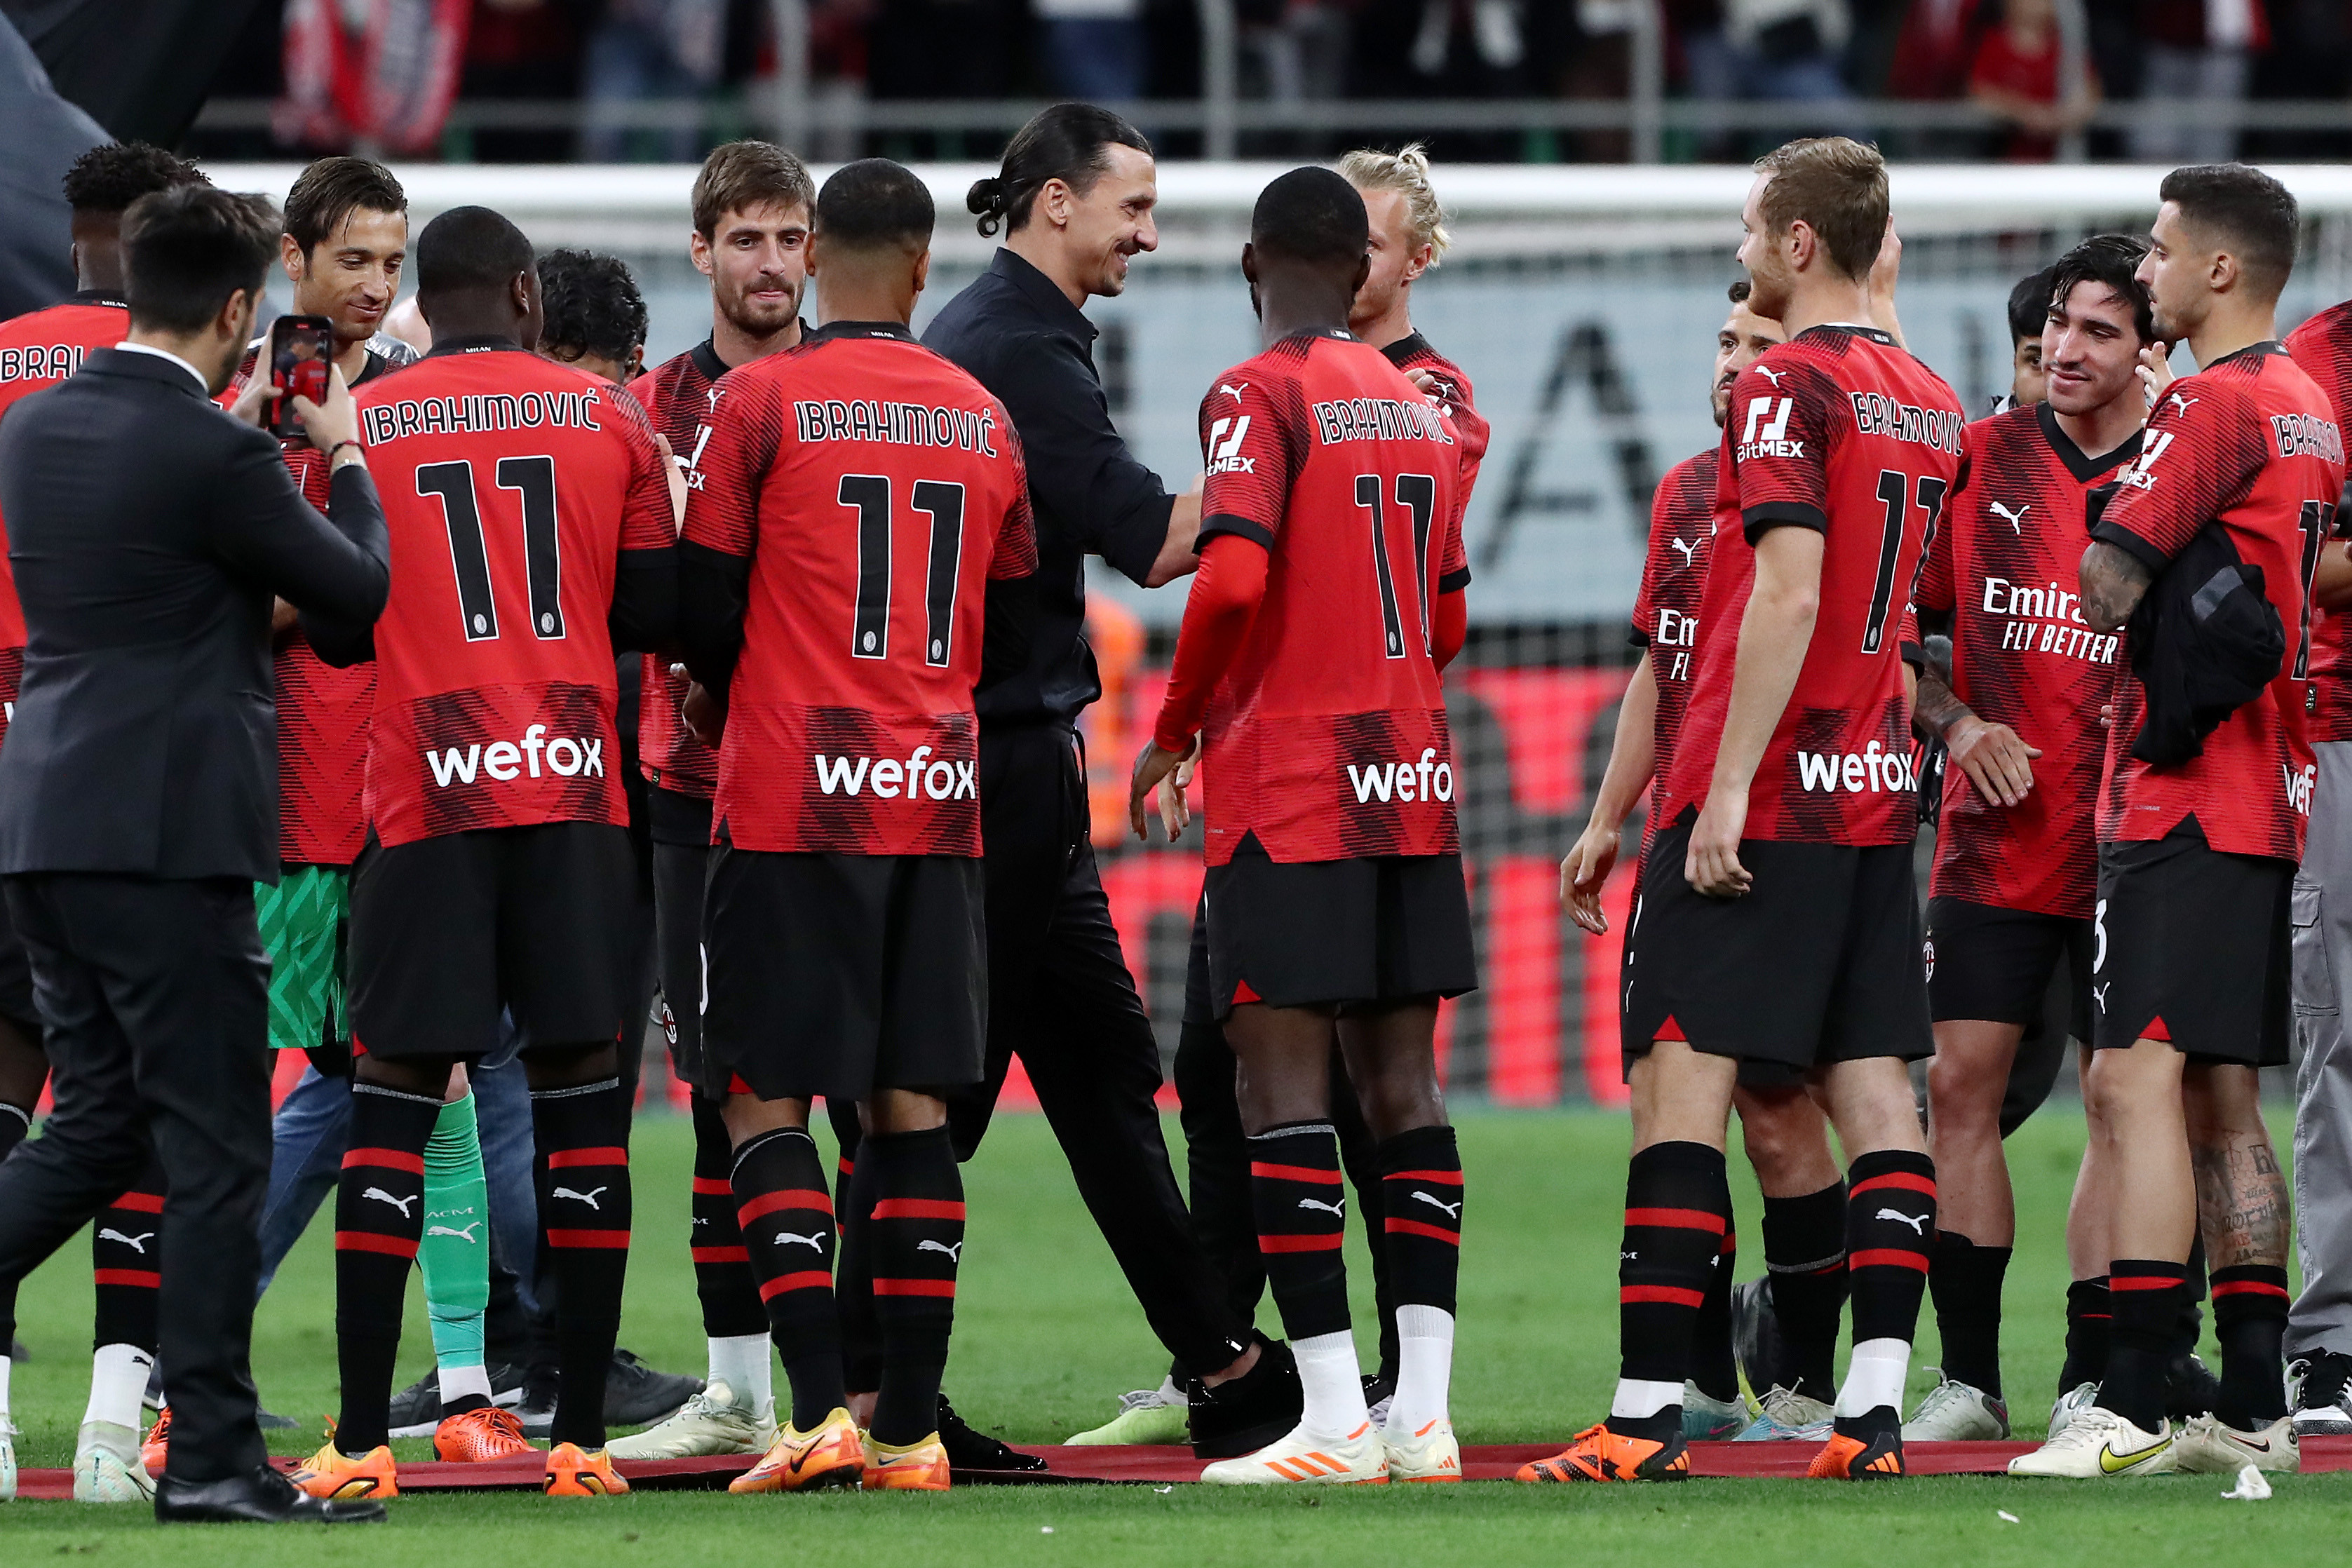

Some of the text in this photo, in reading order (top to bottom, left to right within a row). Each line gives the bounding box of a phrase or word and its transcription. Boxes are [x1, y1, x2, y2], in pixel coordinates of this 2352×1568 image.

[361, 388, 601, 447] IBRAHIMOVIĆ
[793, 399, 997, 459] IBRAHIMOVIĆ
[1737, 440, 1804, 464] BitMEX
[415, 454, 566, 643] 11
[837, 473, 966, 668] 11
[1354, 473, 1435, 658] 11
[2002, 621, 2118, 665] FLY BETTER
[426, 724, 604, 788] wefox
[814, 745, 976, 800] wefox
[1797, 740, 1918, 793] wefox
